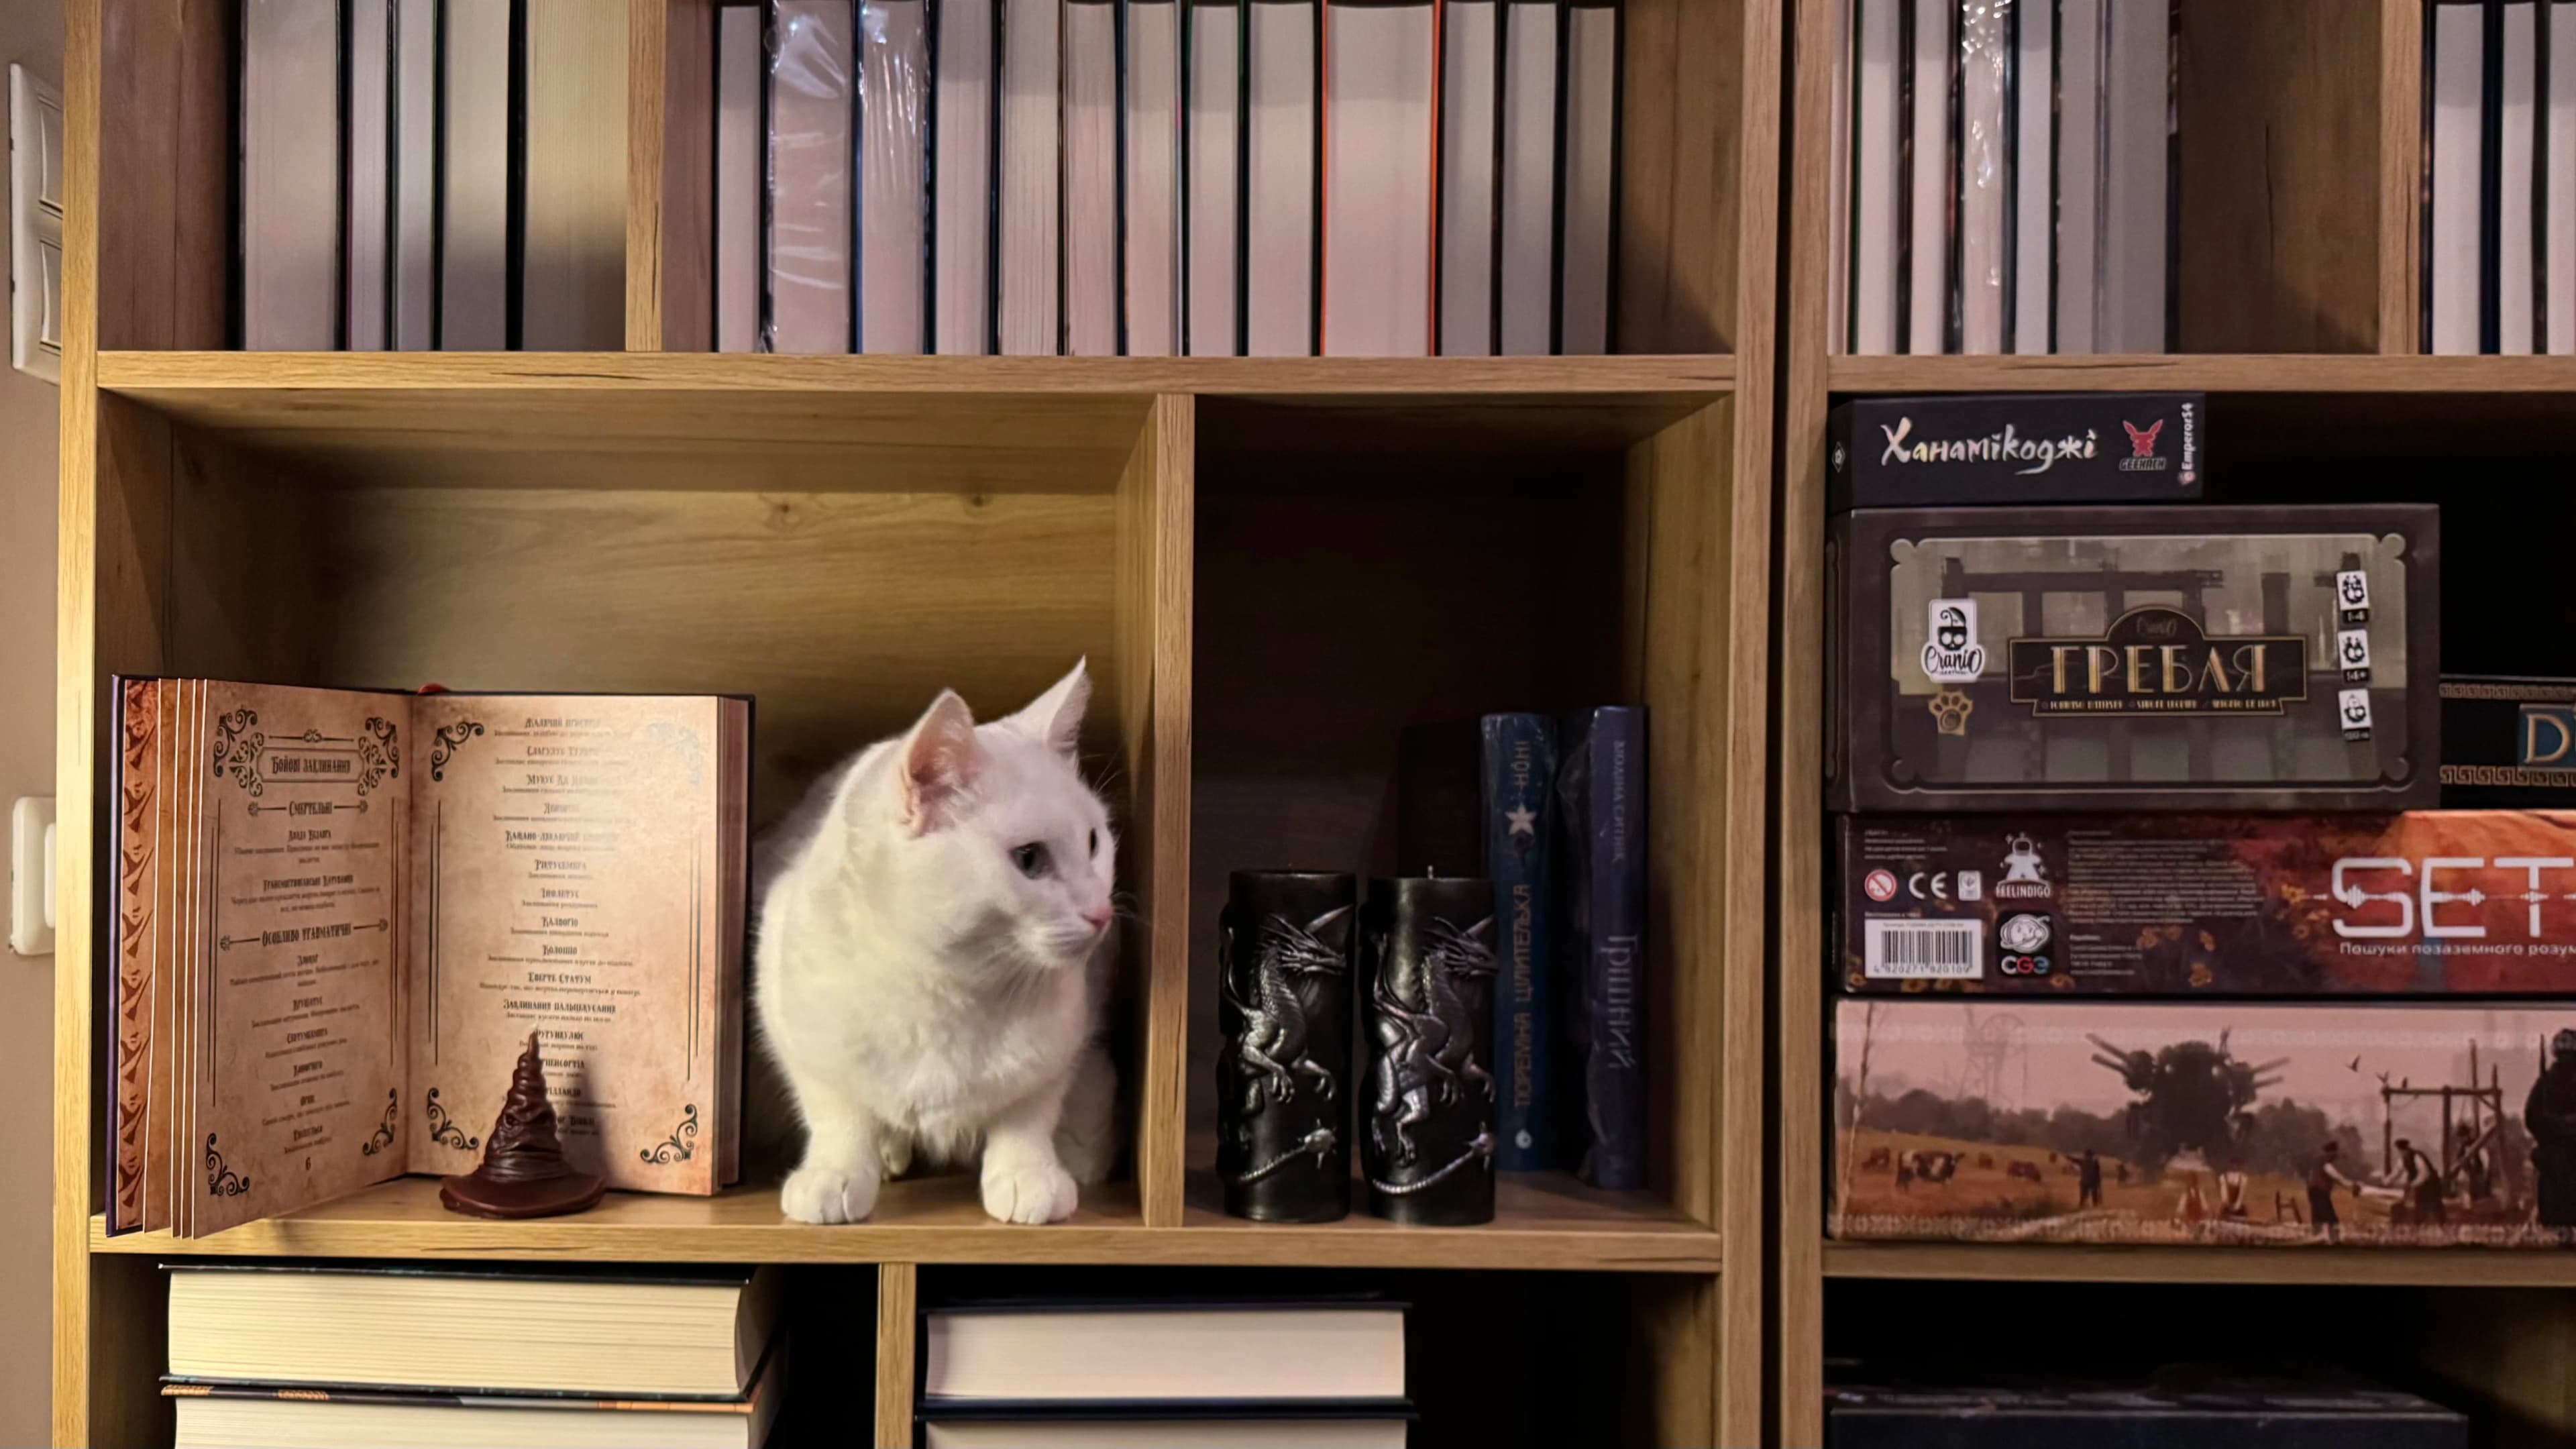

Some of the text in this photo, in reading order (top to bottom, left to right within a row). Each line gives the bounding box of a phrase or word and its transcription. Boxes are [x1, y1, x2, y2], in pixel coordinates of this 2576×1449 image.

[2181, 402, 2196, 470] EmperorS4
[2050, 643, 2267, 694] ГРЕБЛЯ
[2524, 712, 2576, 763] D
[1994, 885, 2052, 899] FEELINDIGO
[2339, 942, 2406, 956] Пошуки
[2412, 945, 2522, 957] позаземного
